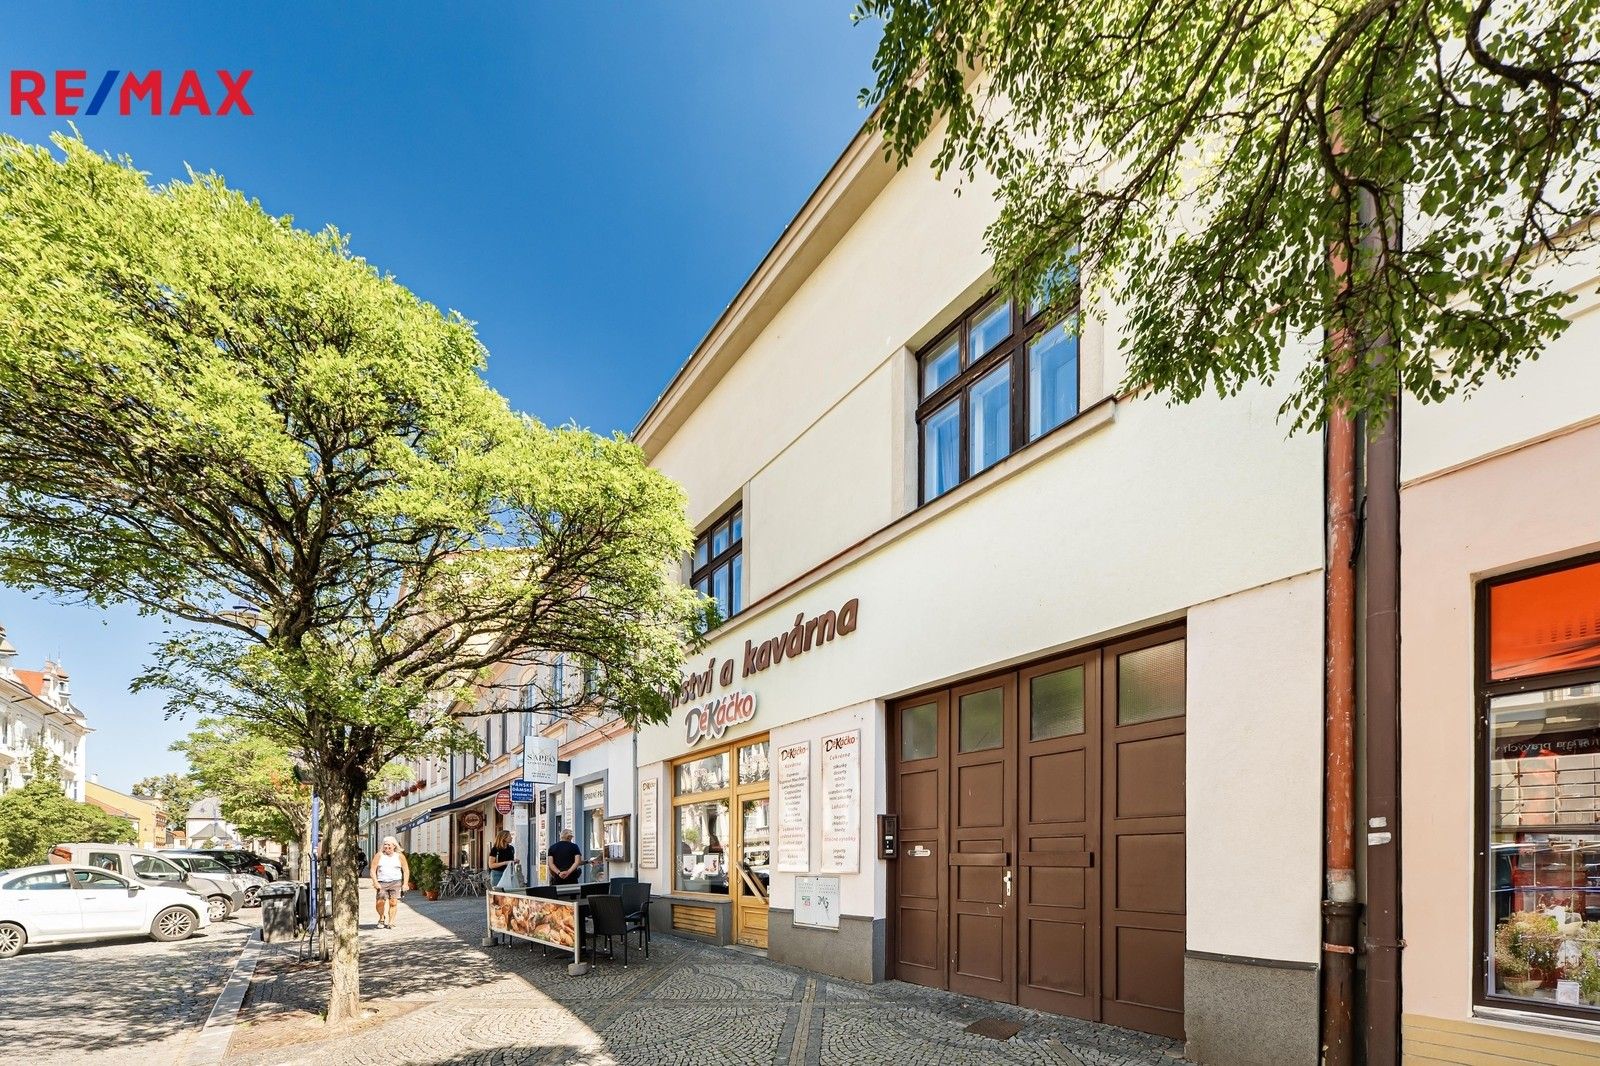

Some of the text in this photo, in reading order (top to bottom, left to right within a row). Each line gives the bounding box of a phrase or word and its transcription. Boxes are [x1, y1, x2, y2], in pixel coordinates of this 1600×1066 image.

[719, 658, 734, 687] a
[742, 598, 859, 678] kavárna
[685, 691, 753, 744] DéKáčko
